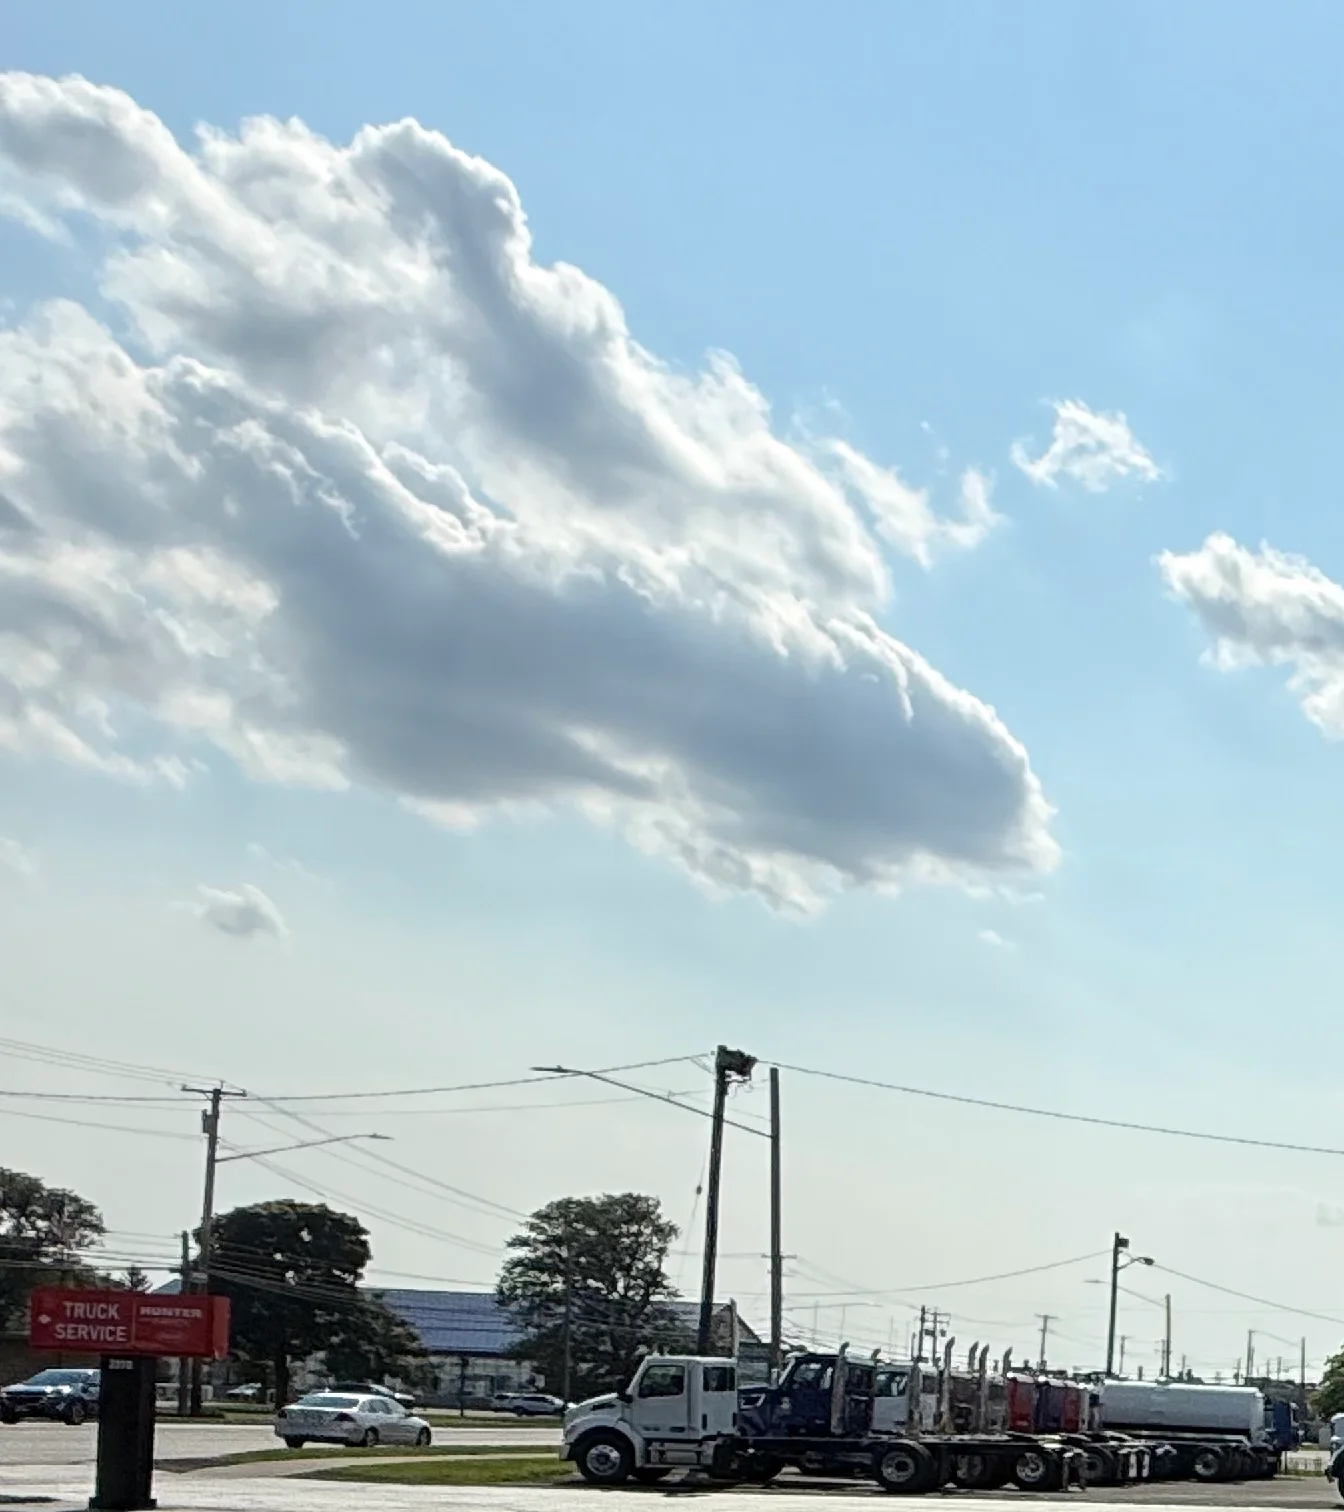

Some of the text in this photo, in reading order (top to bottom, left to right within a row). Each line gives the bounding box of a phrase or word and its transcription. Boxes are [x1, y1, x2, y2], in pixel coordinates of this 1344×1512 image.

[63, 1302, 120, 1320] TRUCK
[140, 1306, 203, 1318] HUNTER
[54, 1323, 128, 1342] SERVICE
